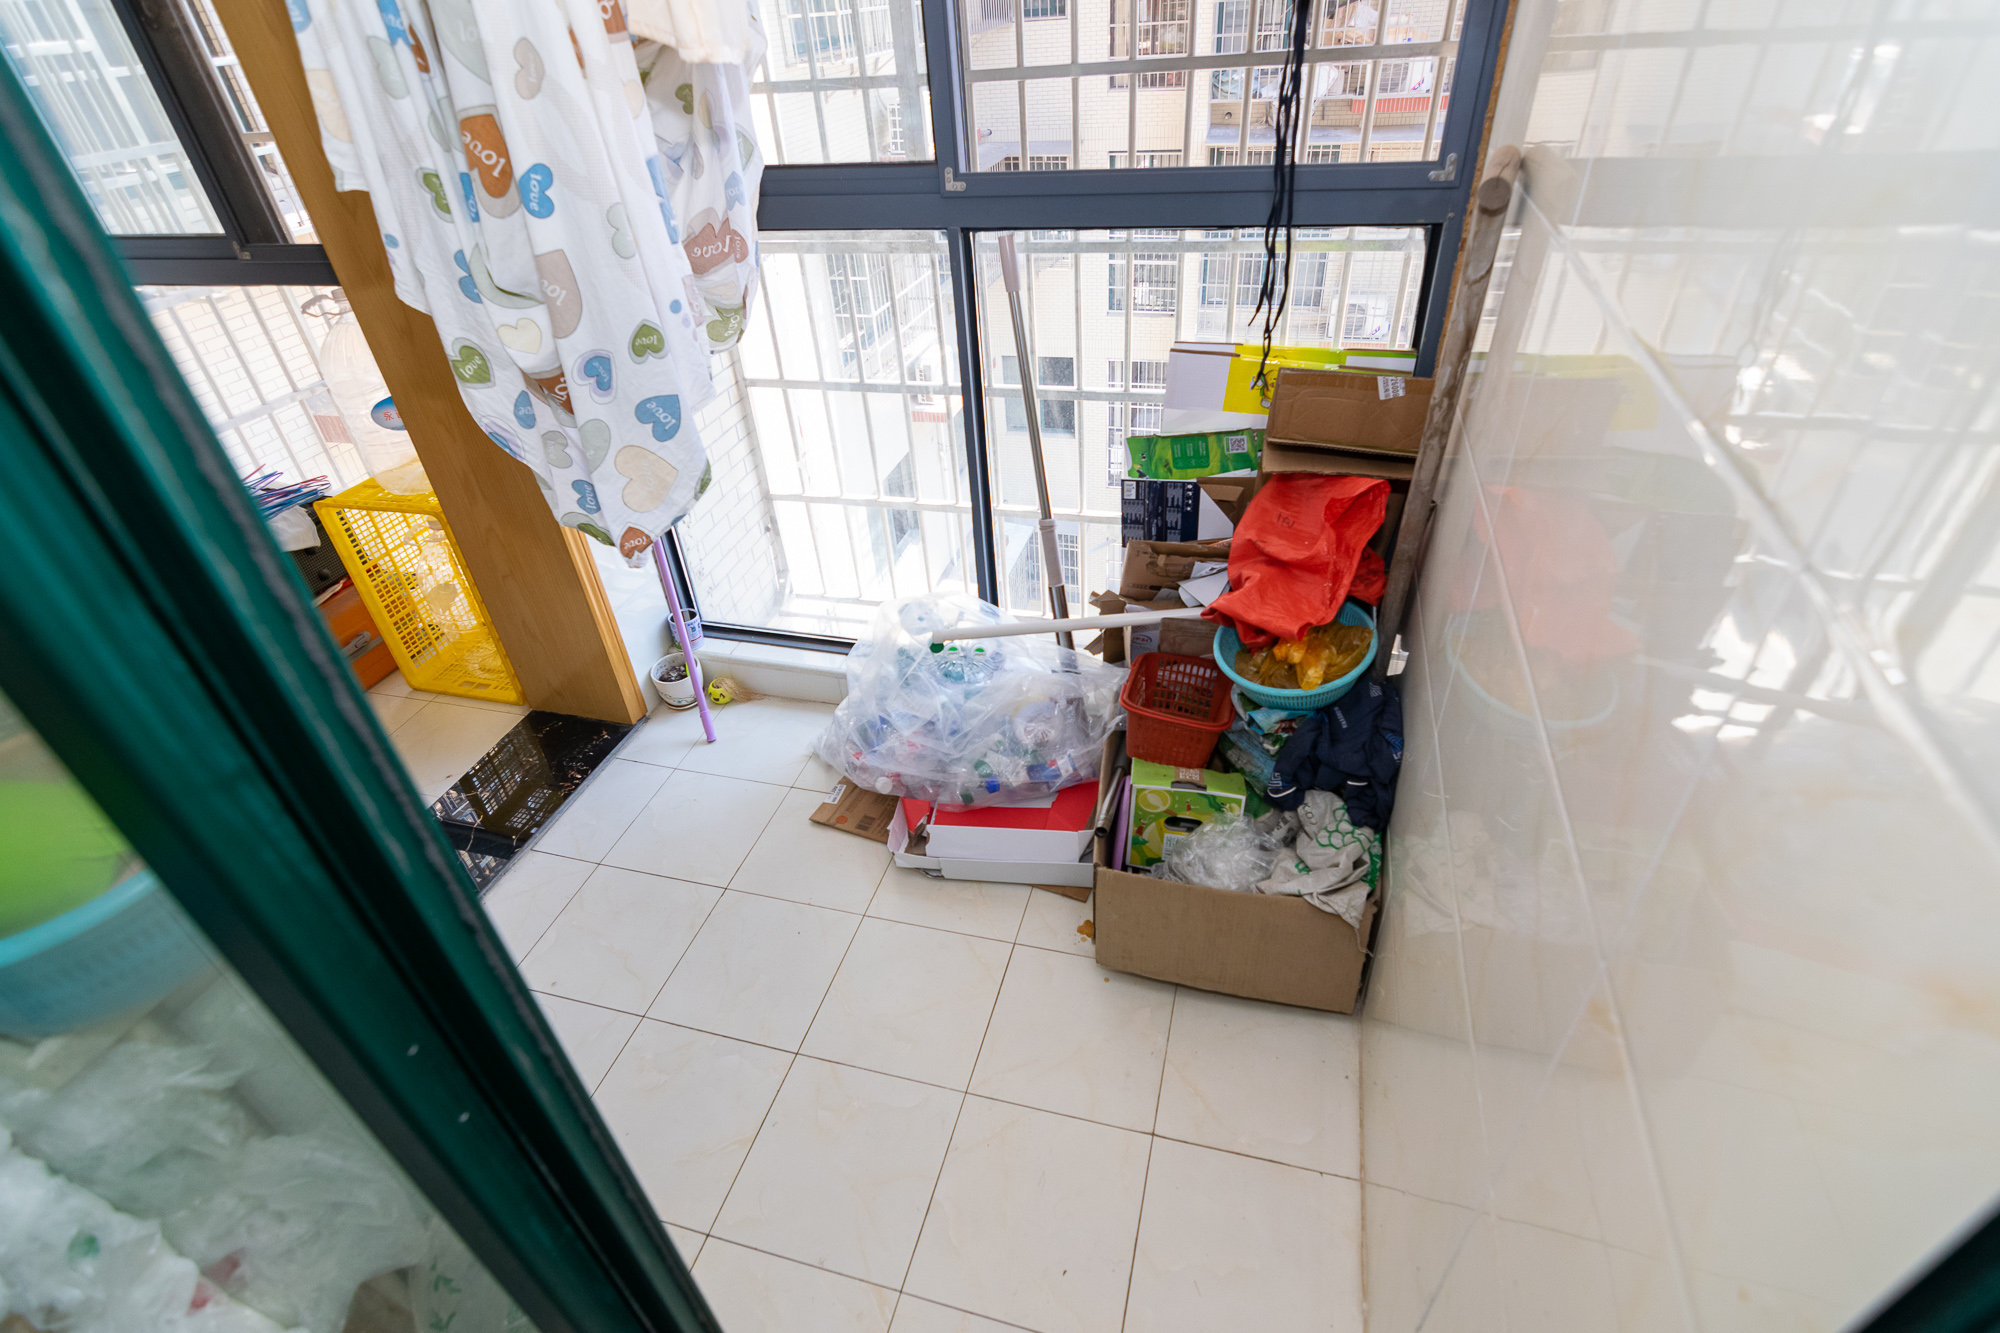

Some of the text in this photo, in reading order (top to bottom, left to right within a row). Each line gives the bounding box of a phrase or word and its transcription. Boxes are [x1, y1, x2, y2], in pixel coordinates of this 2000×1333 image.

[461, 131, 506, 178] love
[529, 172, 542, 212] love
[693, 234, 732, 258] love
[723, 311, 743, 338] love
[635, 335, 658, 346] love
[459, 355, 482, 379] love
[592, 361, 609, 382] love
[646, 401, 677, 430] love
[584, 484, 597, 510] love
[623, 536, 648, 550] love
